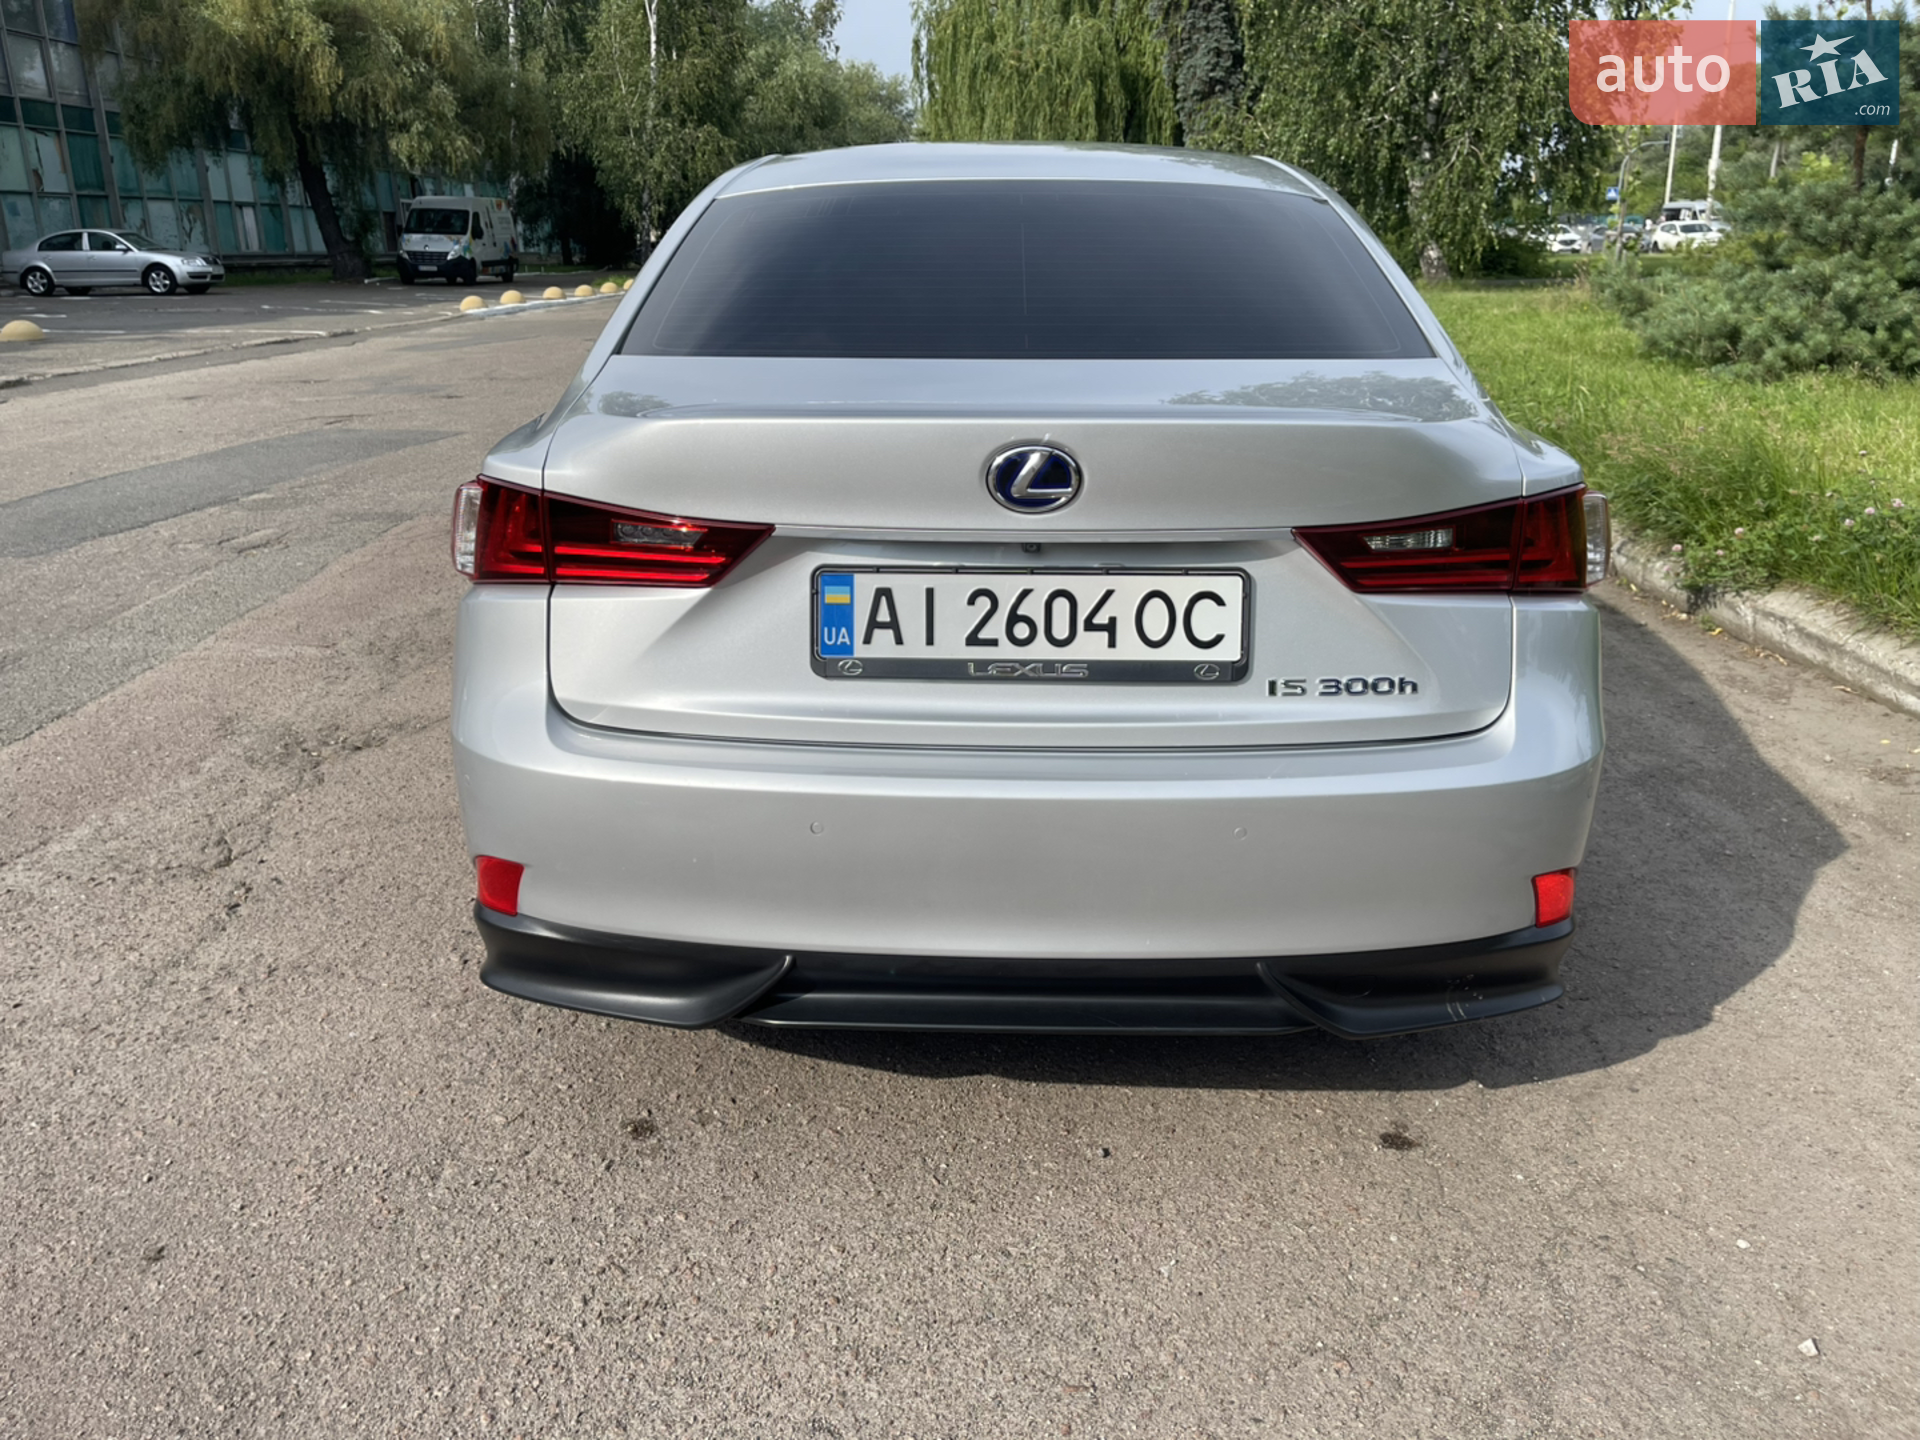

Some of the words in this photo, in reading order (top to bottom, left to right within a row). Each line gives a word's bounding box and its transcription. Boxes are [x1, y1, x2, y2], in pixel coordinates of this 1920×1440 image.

[862, 586, 935, 646] AI
[964, 587, 1117, 649] 2604
[1134, 589, 1227, 649] OC
[823, 628, 851, 646] UA
[967, 661, 1089, 678] LEXUS
[1266, 677, 1308, 697] IS
[1316, 675, 1419, 697] 300h
